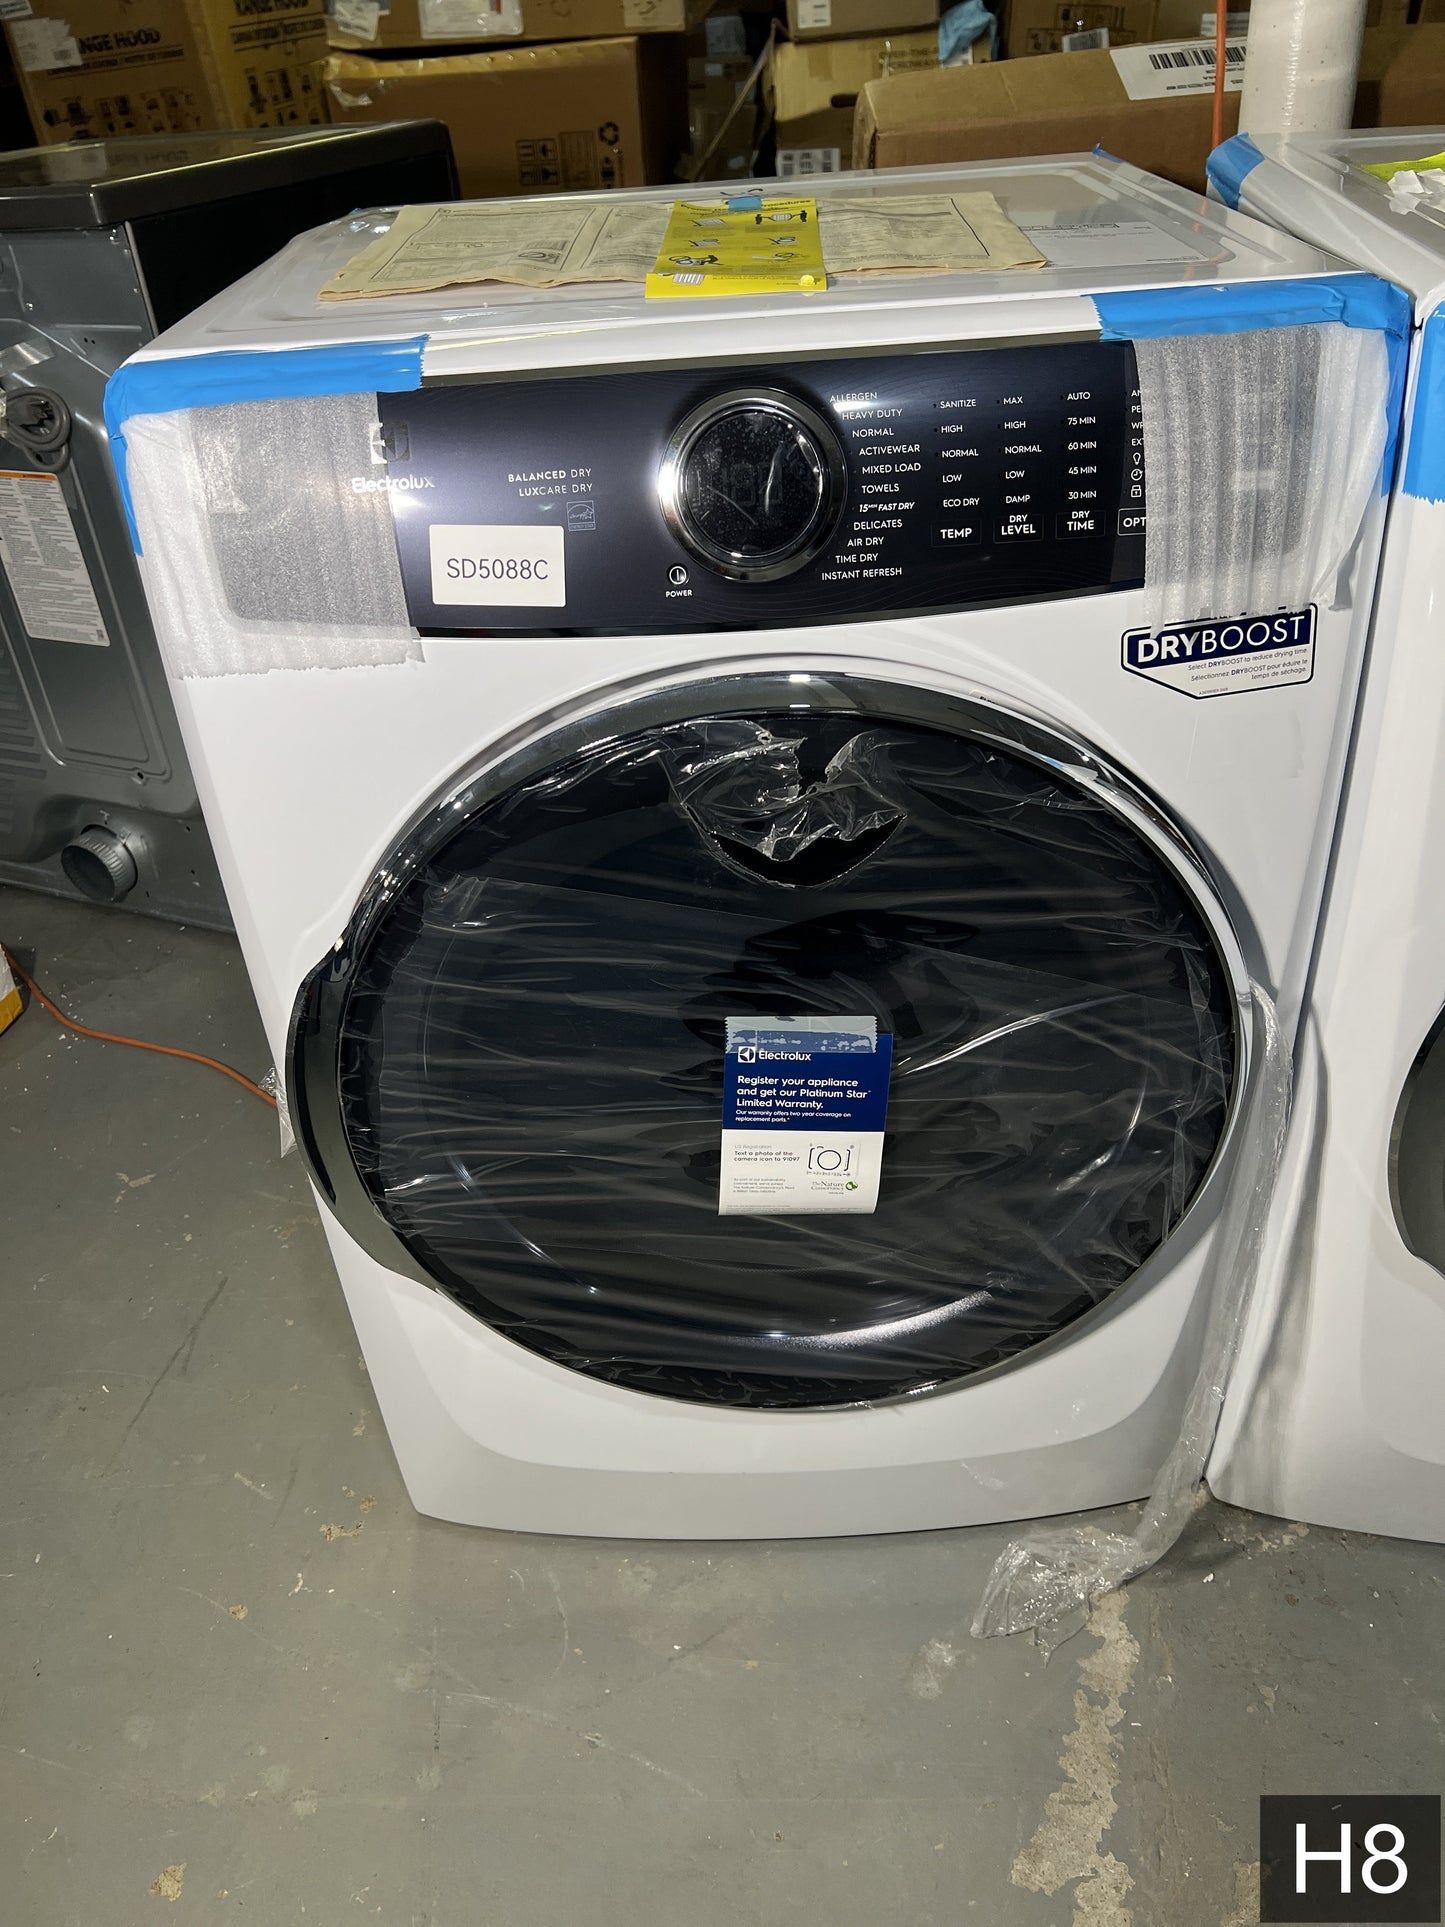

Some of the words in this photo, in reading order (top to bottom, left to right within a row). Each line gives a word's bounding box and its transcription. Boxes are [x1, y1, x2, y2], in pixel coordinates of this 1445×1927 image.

[829, 392, 878, 403] ALLERGEN
[1003, 396, 1024, 405] MAX
[1067, 391, 1091, 401] AUTO
[940, 398, 977, 409] SANITIZE
[1131, 405, 1142, 413] PE
[842, 410, 874, 420] HEAVY
[877, 408, 903, 418] DUTY
[1004, 420, 1026, 430] HIGH
[1067, 417, 1078, 426] 75
[1079, 416, 1096, 425] MIN
[852, 428, 894, 438] NORMAL
[941, 424, 963, 433] HIGH
[859, 444, 921, 456] ACTIVEWEAR
[1005, 444, 1042, 454] NORMAL
[1068, 441, 1079, 451] 60
[1080, 440, 1097, 449] MIN
[942, 448, 979, 458] NORMAL
[862, 464, 893, 475] MIXED
[894, 462, 921, 472] LOAD
[1068, 466, 1079, 475] 45
[1080, 465, 1097, 474] MIN
[508, 470, 566, 483] BALANCED
[570, 468, 592, 479] DRY
[942, 473, 962, 483] LOW
[1005, 470, 1025, 479] LOW
[351, 473, 436, 494] Electrolux
[861, 483, 900, 494] TOWELS
[518, 485, 568, 497] LUXCARE
[572, 483, 593, 494] DRY
[1068, 491, 1079, 500] 30
[1080, 490, 1097, 499] MIN
[943, 498, 961, 508] ECO
[963, 497, 980, 507] DRY
[1005, 495, 1031, 504] DAMP
[878, 502, 897, 511] FAST
[898, 501, 915, 510] DRY
[1009, 514, 1028, 523] DRY
[1071, 510, 1090, 519] DRY
[853, 519, 903, 531] DELICATES
[1067, 519, 1095, 531] TIME
[1122, 516, 1146, 528] OPT
[940, 528, 973, 539] TEMP
[1001, 523, 1036, 536] LEVEL
[847, 538, 863, 547] AIR
[865, 536, 884, 546] DRY
[835, 554, 857, 564] TIME
[859, 553, 879, 562] DRY
[447, 557, 548, 580] SD5088C
[821, 570, 860, 581] INSTANT
[863, 567, 903, 578] REFRESH
[665, 589, 693, 598] POWER
[1137, 615, 1305, 663] DRYBOOST
[1188, 663, 1207, 671] Select
[1208, 656, 1244, 667] DRYBOOST
[1244, 655, 1251, 663] to
[1252, 652, 1273, 661] reduce
[1274, 648, 1294, 660] drying
[1191, 670, 1230, 681] Sélectionnez
[1231, 664, 1266, 676] DRYBOOST
[1267, 663, 1281, 672] pour
[1251, 671, 1270, 681] temps
[1271, 670, 1280, 678] de
[758, 1050, 812, 1061] Electrolux
[737, 1075, 779, 1086] Register
[781, 1077, 805, 1087] your
[807, 1078, 859, 1088] appliance
[737, 1087, 757, 1096] and
[759, 1088, 777, 1098] get
[779, 1089, 798, 1097] our
[799, 1088, 843, 1098] Platinum
[736, 1098, 773, 1108] Limited
[775, 1099, 824, 1109] Warranty.
[747, 1109, 773, 1118] warranty
[815, 1111, 843, 1119] coverage
[821, 1180, 844, 1188] Nature
